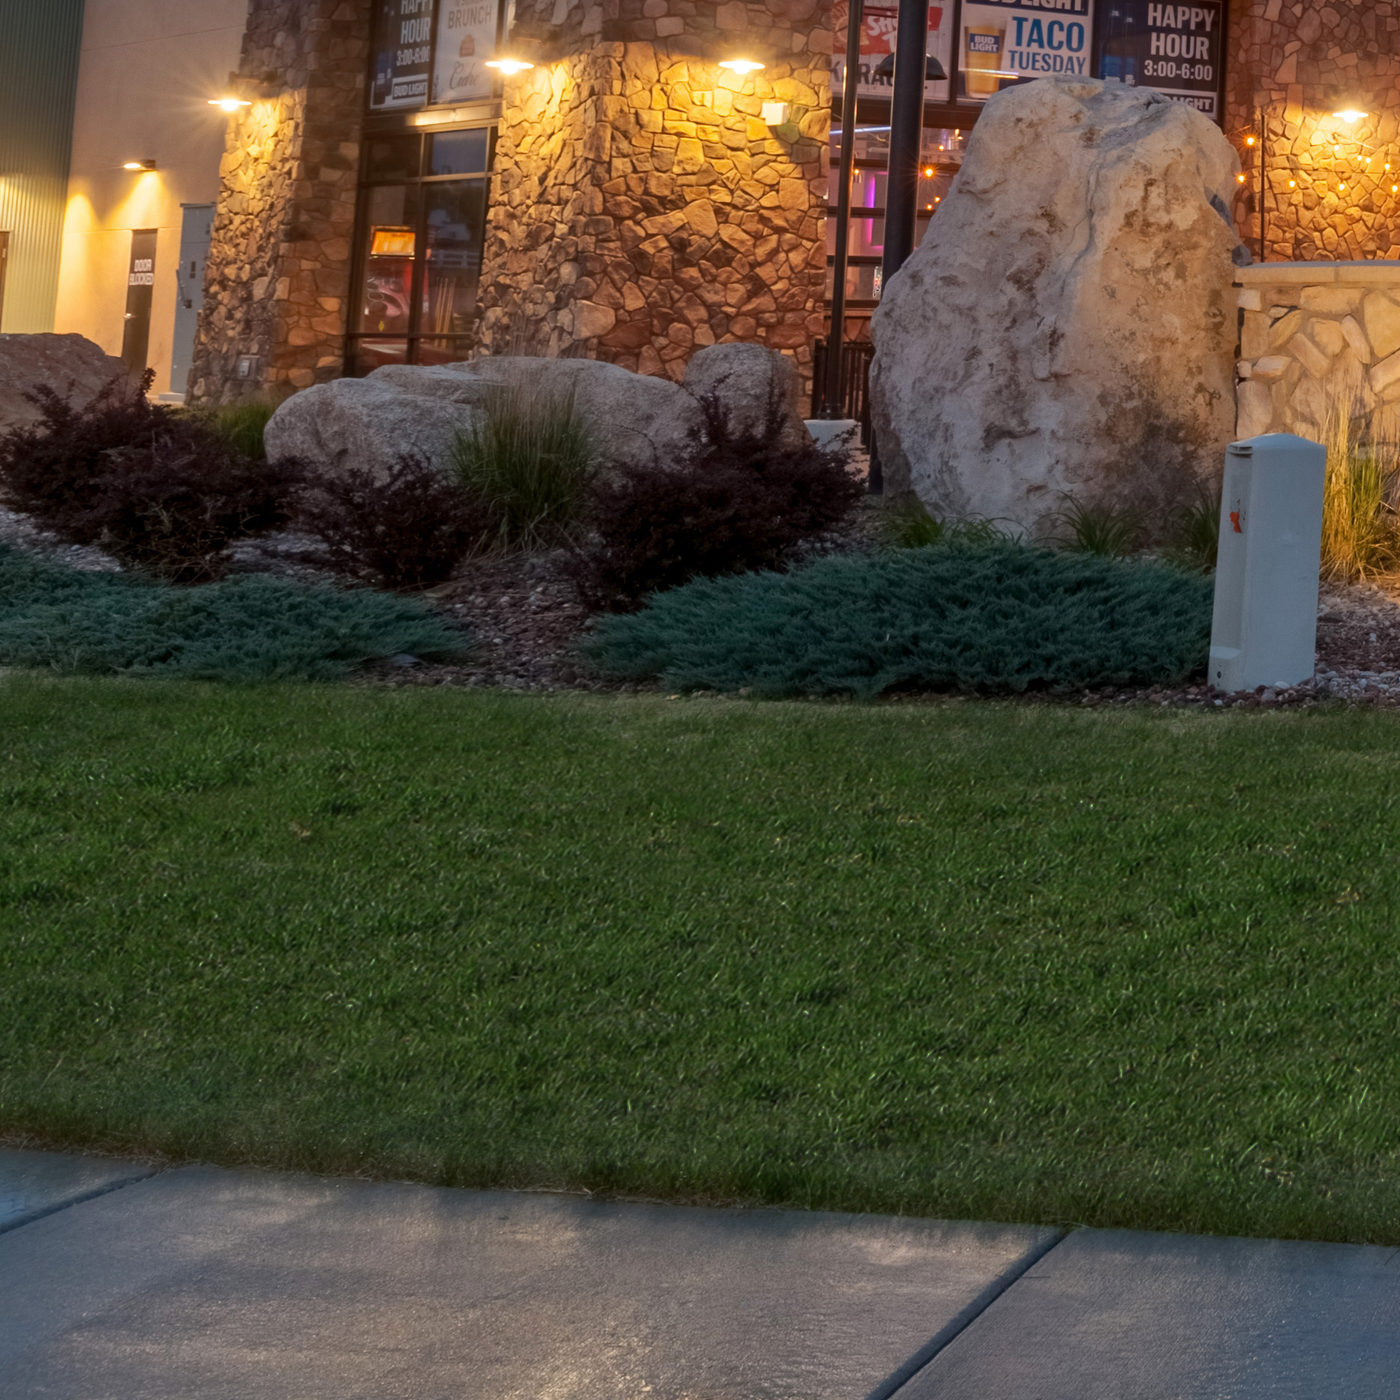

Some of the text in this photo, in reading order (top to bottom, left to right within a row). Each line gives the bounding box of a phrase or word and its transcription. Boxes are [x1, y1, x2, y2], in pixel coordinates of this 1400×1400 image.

[448, 5, 492, 29] BRUNCH
[1147, 3, 1215, 32] HAPPY
[400, 17, 431, 44] HOUR
[974, 35, 995, 44] BUD
[1012, 16, 1084, 52] TACO
[970, 42, 999, 52] LIGHT
[1150, 32, 1209, 60] HOUR
[1008, 50, 1086, 74] TUESDAY
[1144, 60, 1213, 81] 3:00-6:00
